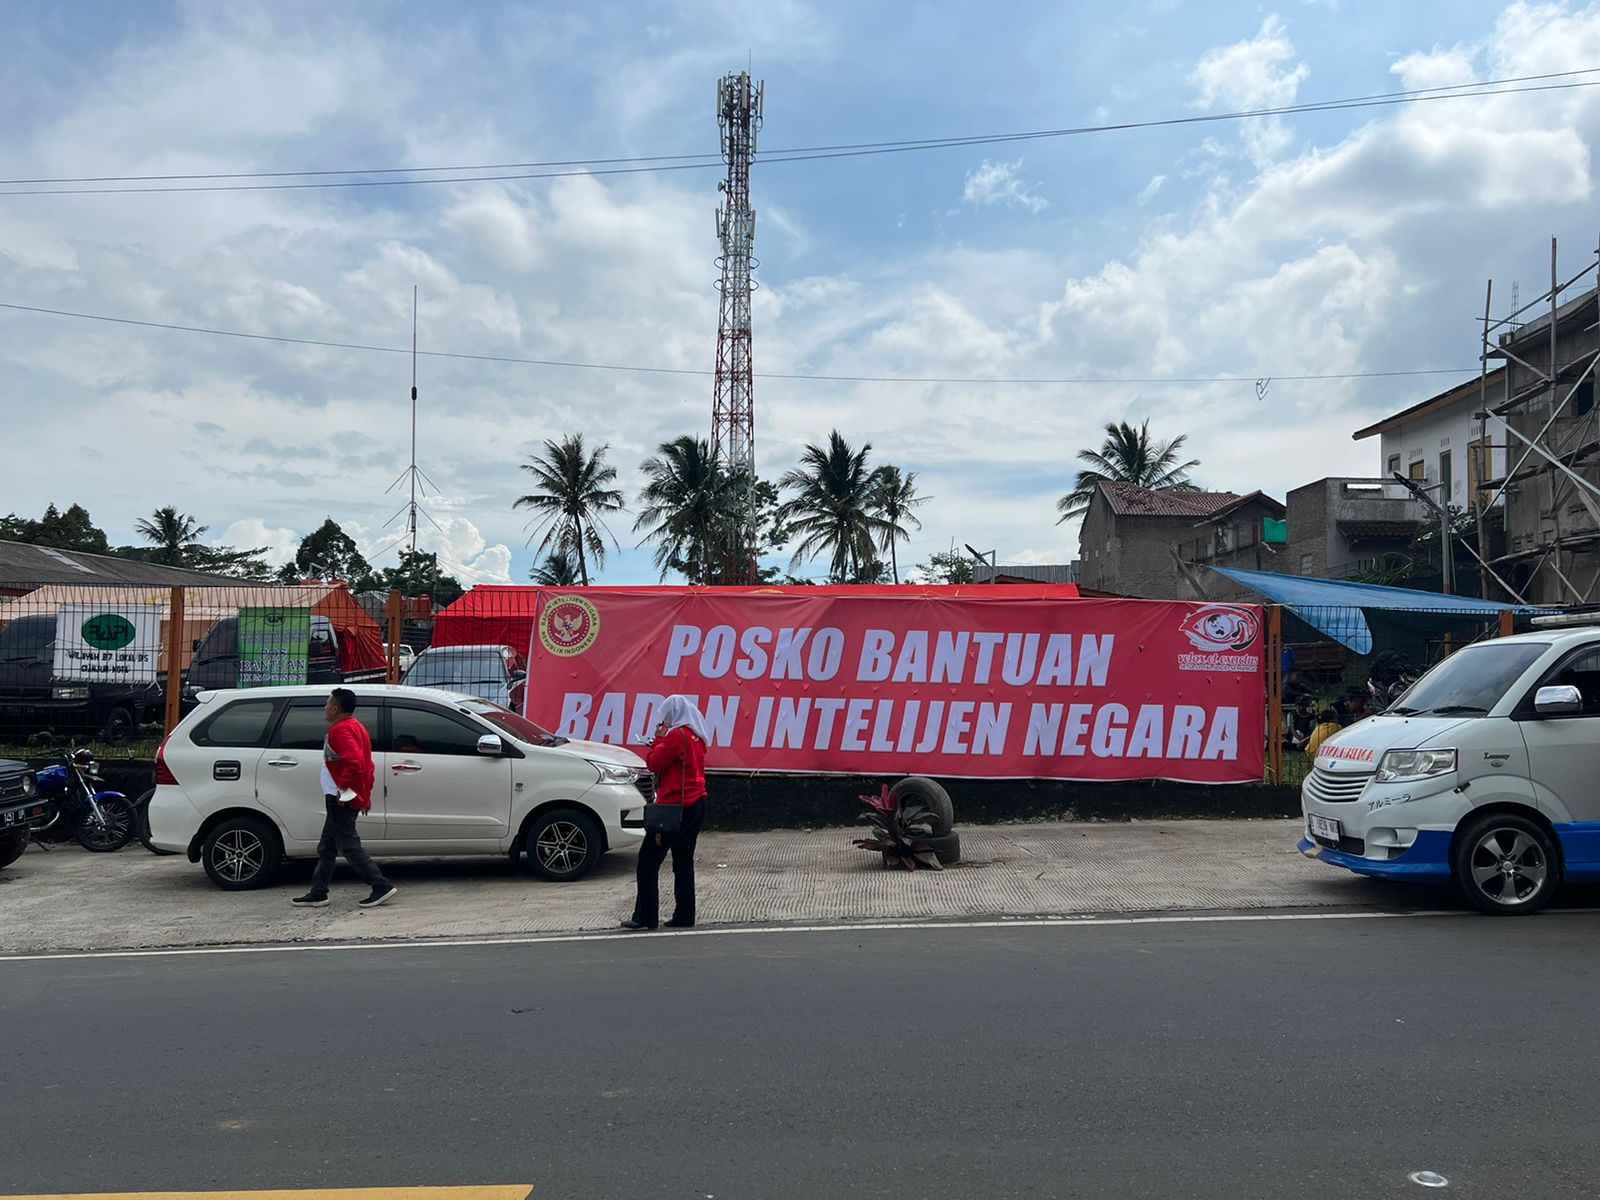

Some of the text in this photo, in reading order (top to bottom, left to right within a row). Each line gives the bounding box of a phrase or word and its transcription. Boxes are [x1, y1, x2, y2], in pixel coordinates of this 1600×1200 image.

[663, 625, 1114, 686] POSKO BANTUAN
[557, 693, 1238, 760] BADN INTELIJEN NEGARA
